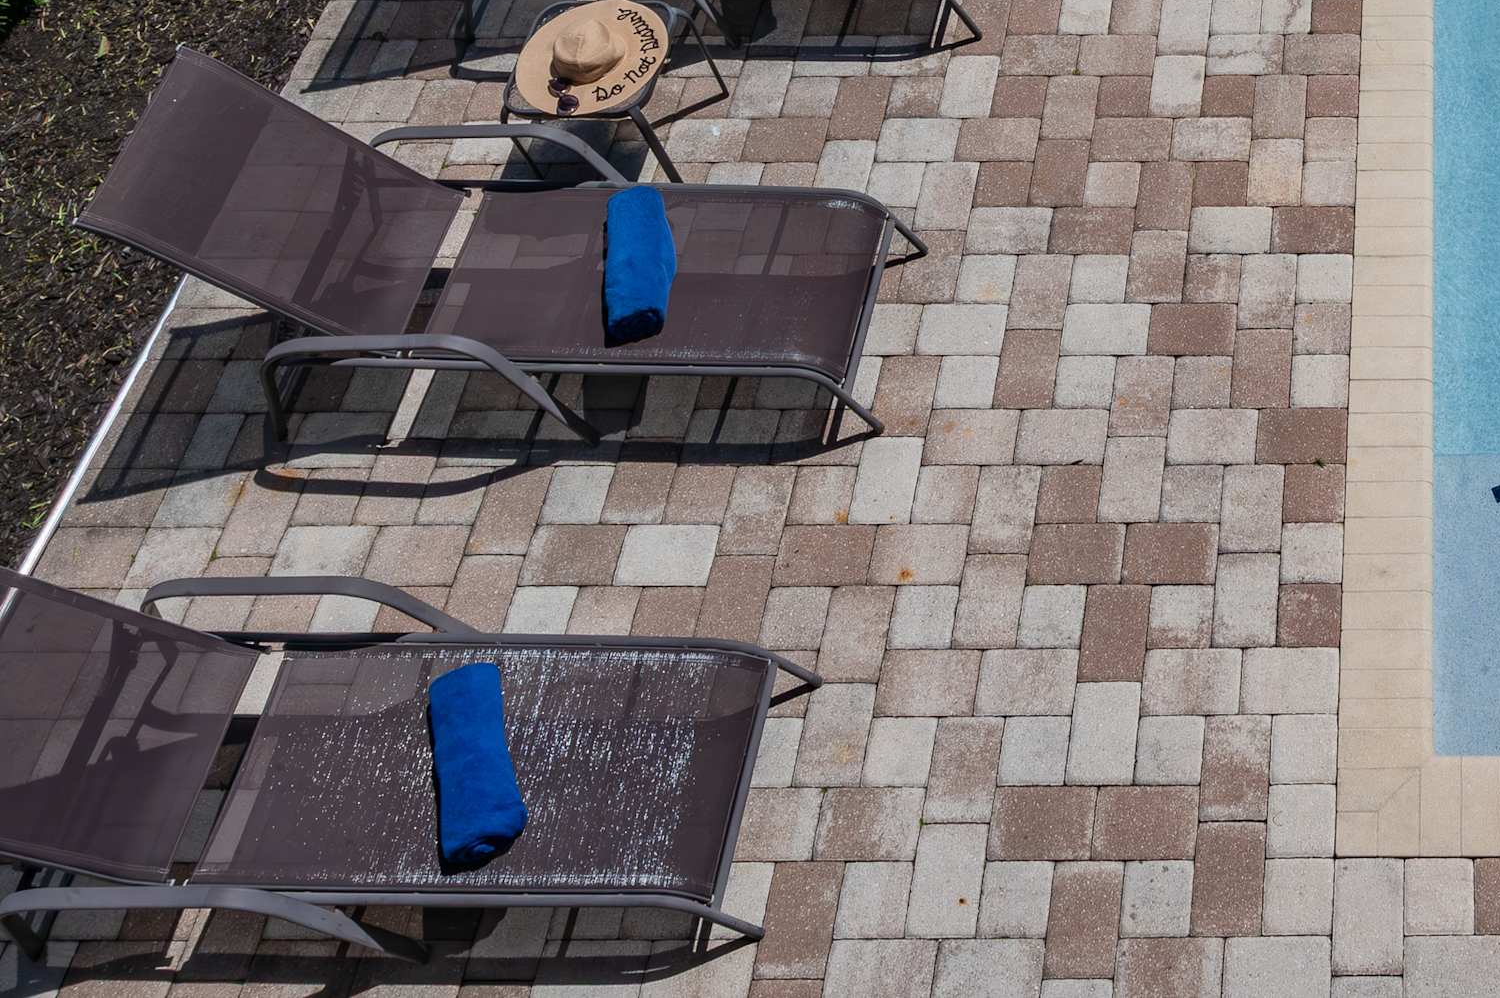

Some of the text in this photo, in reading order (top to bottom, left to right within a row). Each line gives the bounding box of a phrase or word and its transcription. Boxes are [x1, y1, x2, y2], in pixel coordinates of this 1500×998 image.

[592, 7, 660, 102] Do Not Disturb
